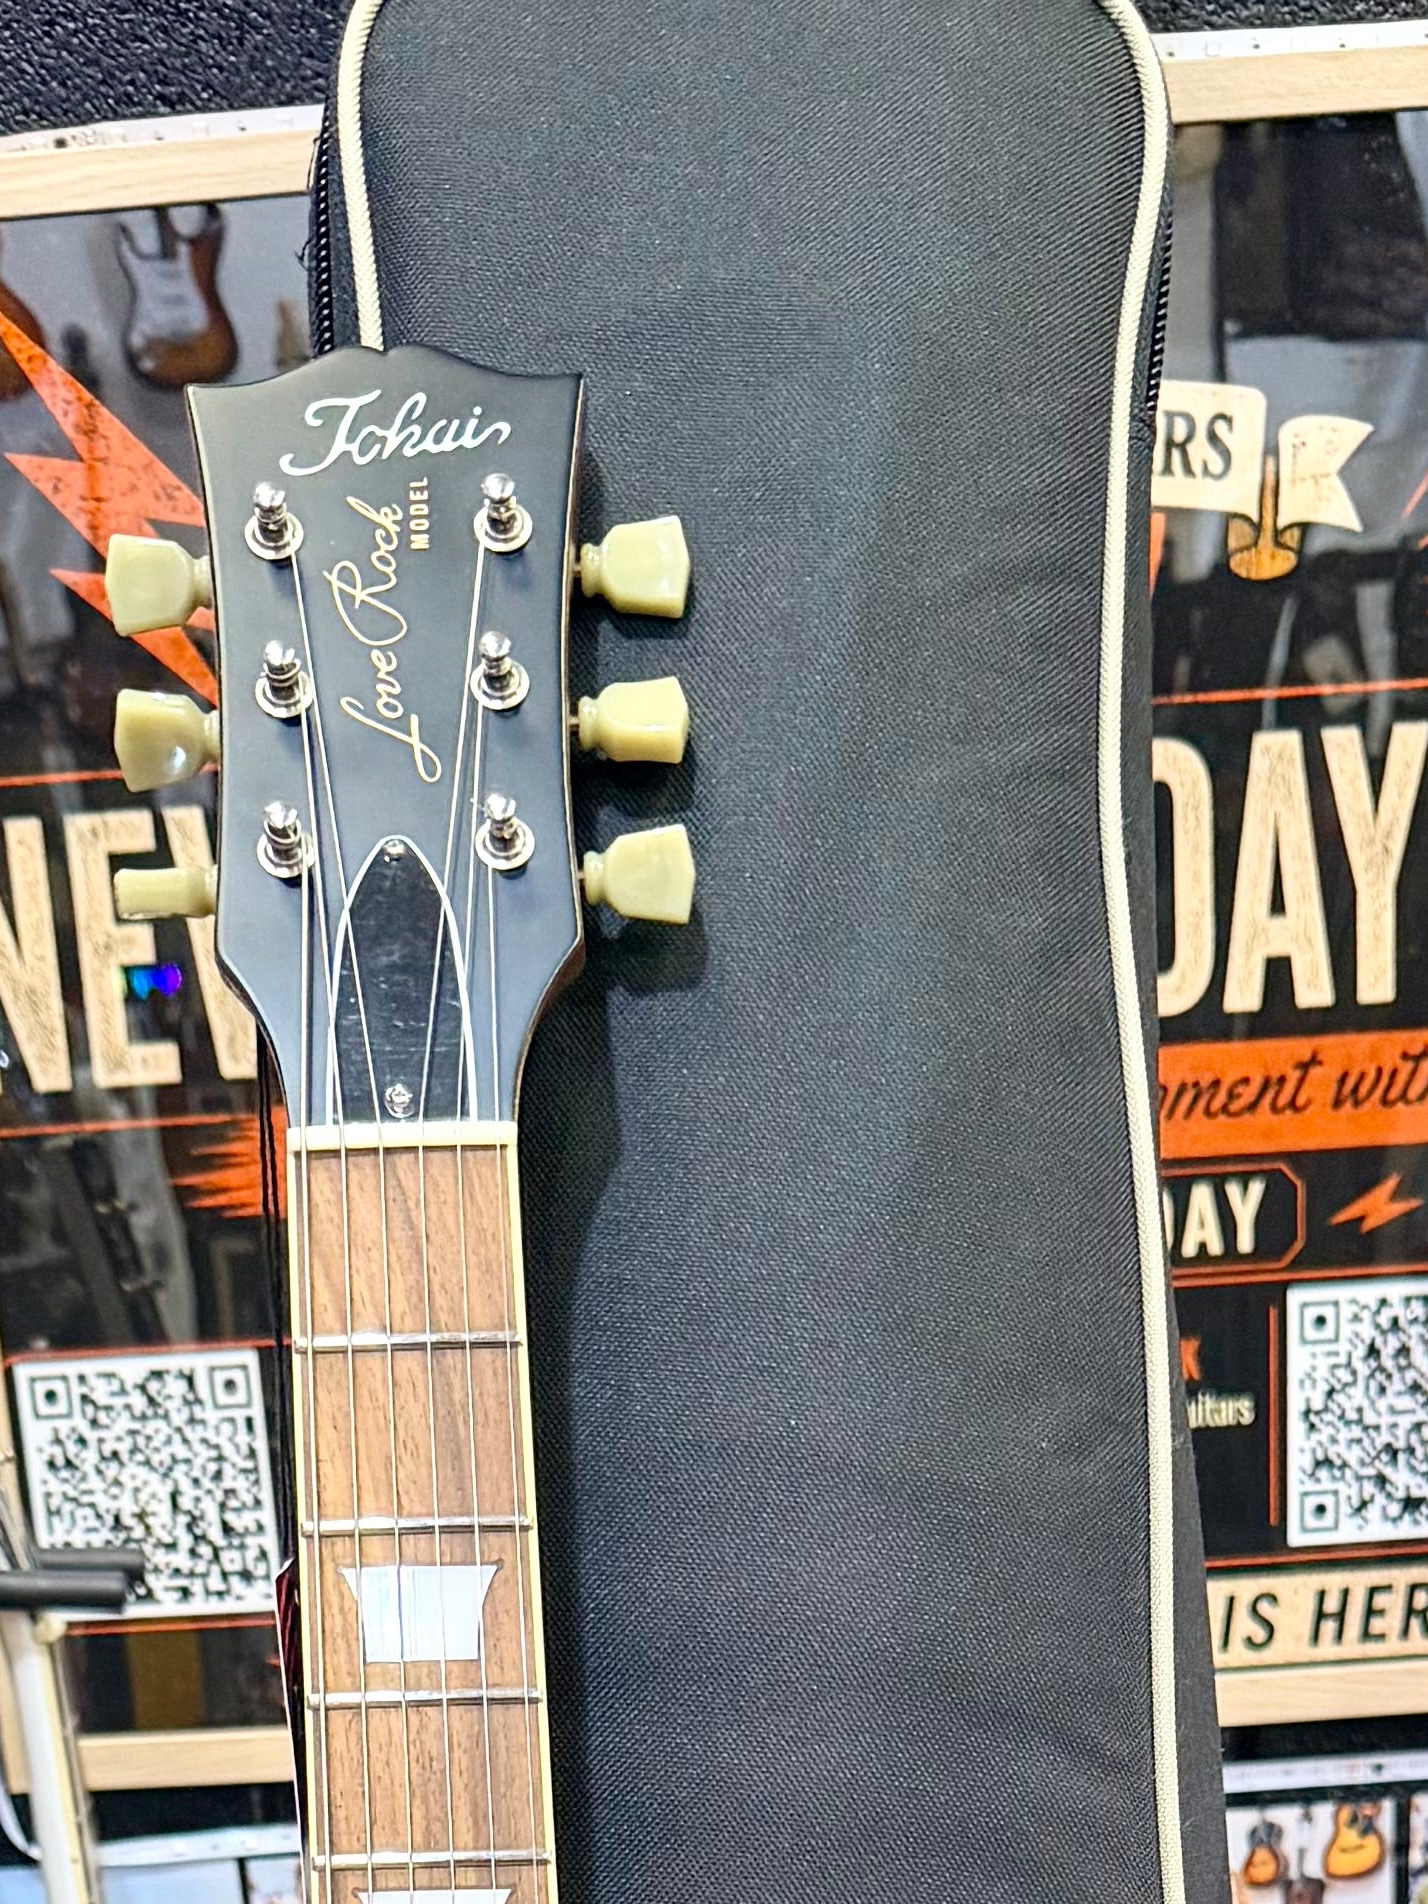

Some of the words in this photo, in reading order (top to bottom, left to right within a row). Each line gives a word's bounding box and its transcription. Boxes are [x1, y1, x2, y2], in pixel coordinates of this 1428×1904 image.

[279, 388, 513, 477] Tokai
[408, 475, 430, 551] MODEL
[323, 496, 408, 646] Rock
[339, 643, 442, 784] Love
[1219, 1592, 1280, 1654] IS
